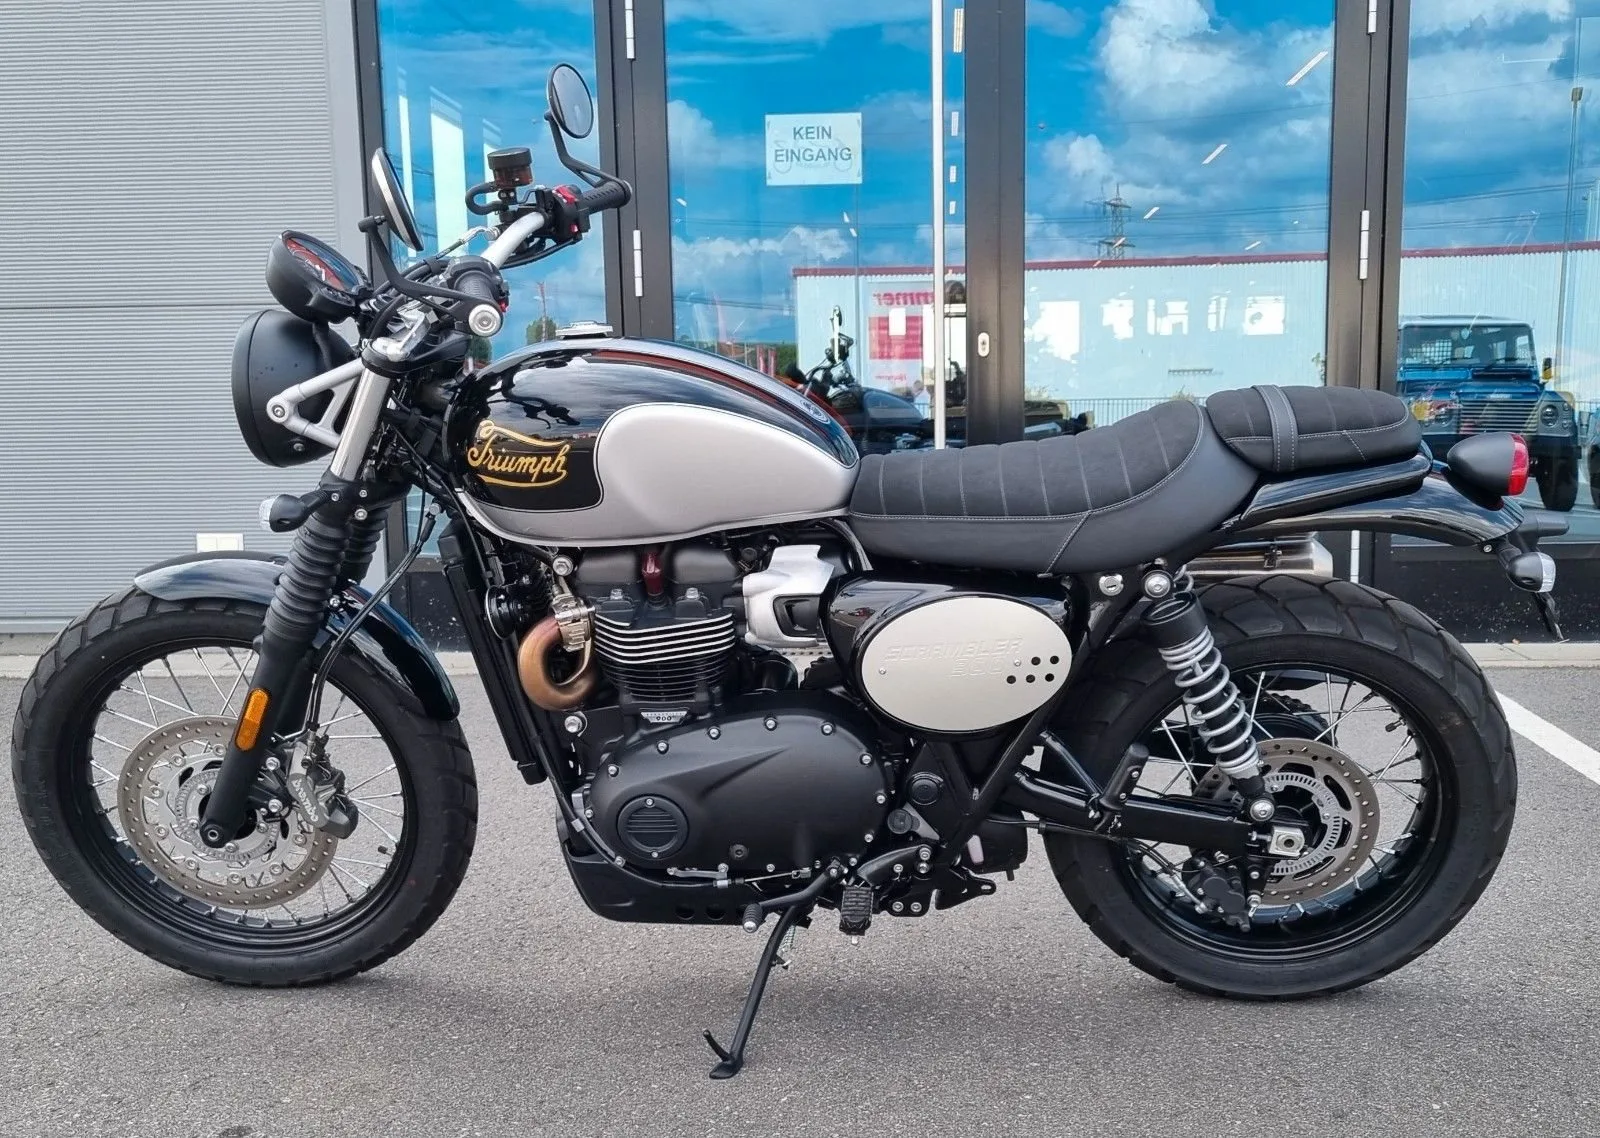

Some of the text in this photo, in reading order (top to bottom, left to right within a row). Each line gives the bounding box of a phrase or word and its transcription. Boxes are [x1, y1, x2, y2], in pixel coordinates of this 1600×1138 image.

[793, 126, 832, 140] KEIN
[774, 147, 852, 162] EINGANG
[468, 420, 571, 487] Triumph
[883, 637, 1023, 661] SCRAMBLER
[291, 778, 319, 822] brembo
